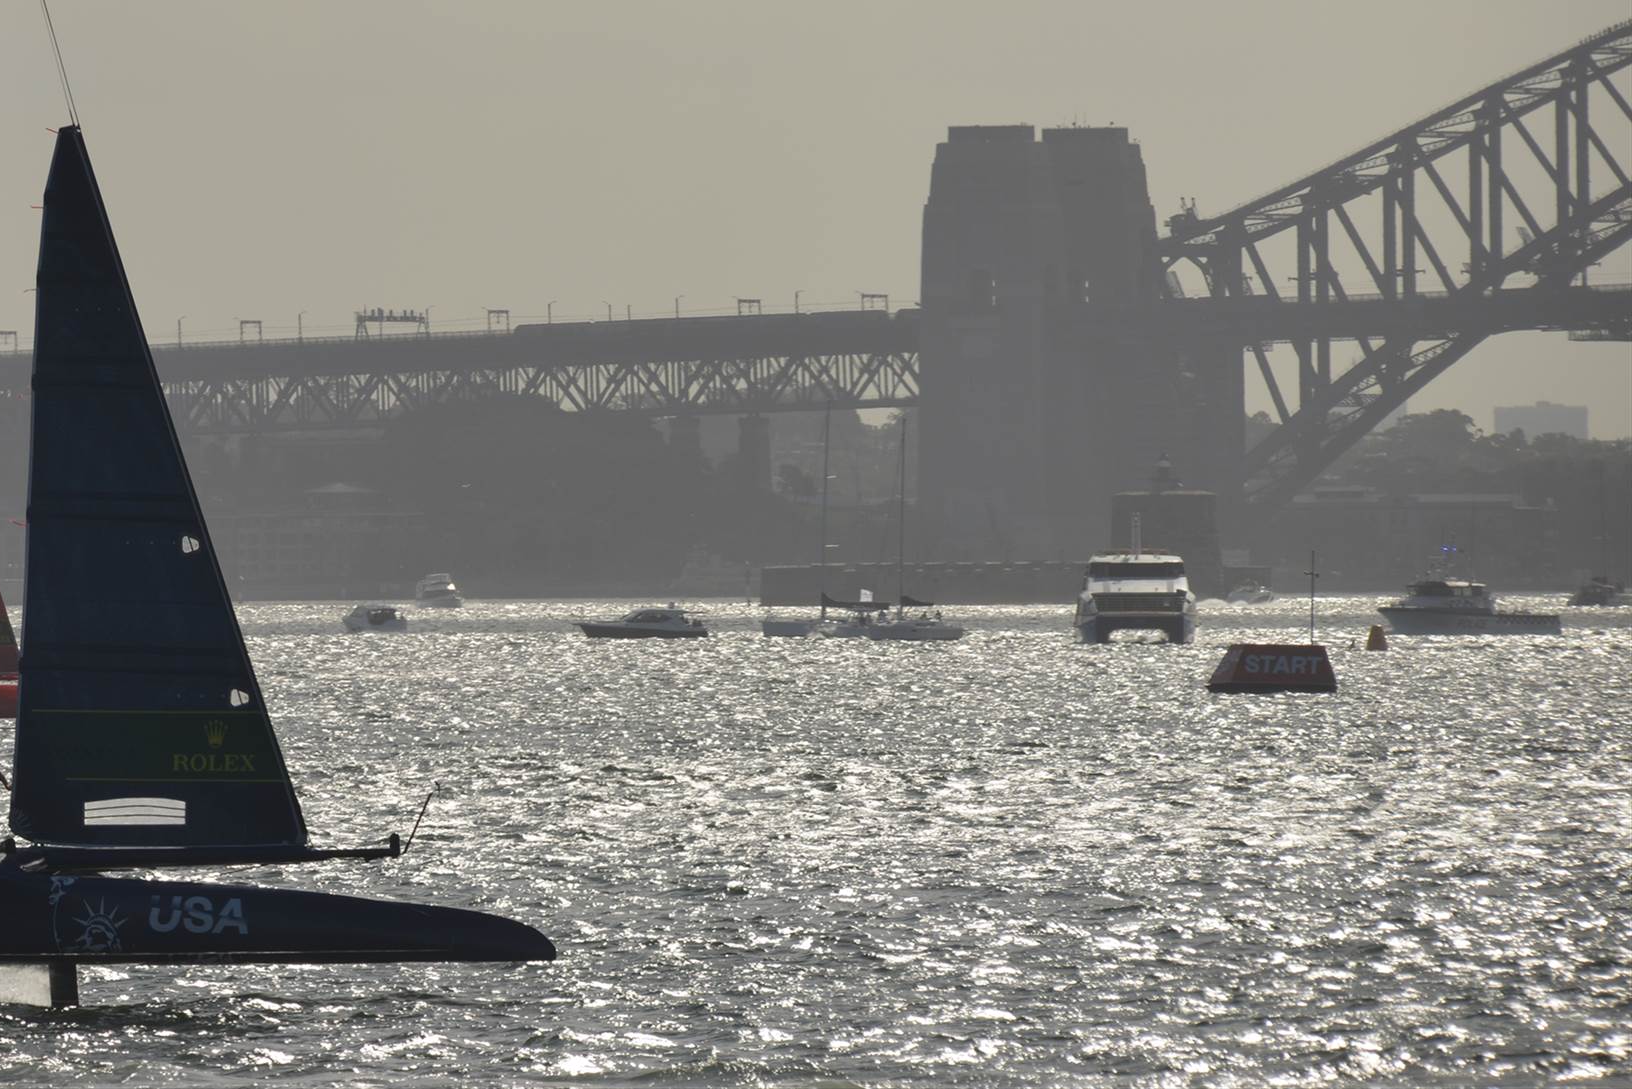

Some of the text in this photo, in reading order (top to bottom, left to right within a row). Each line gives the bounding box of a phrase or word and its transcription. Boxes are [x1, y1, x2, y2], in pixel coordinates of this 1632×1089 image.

[1245, 655, 1323, 674] START
[172, 753, 255, 772] ROLEX
[149, 894, 248, 934] USA
